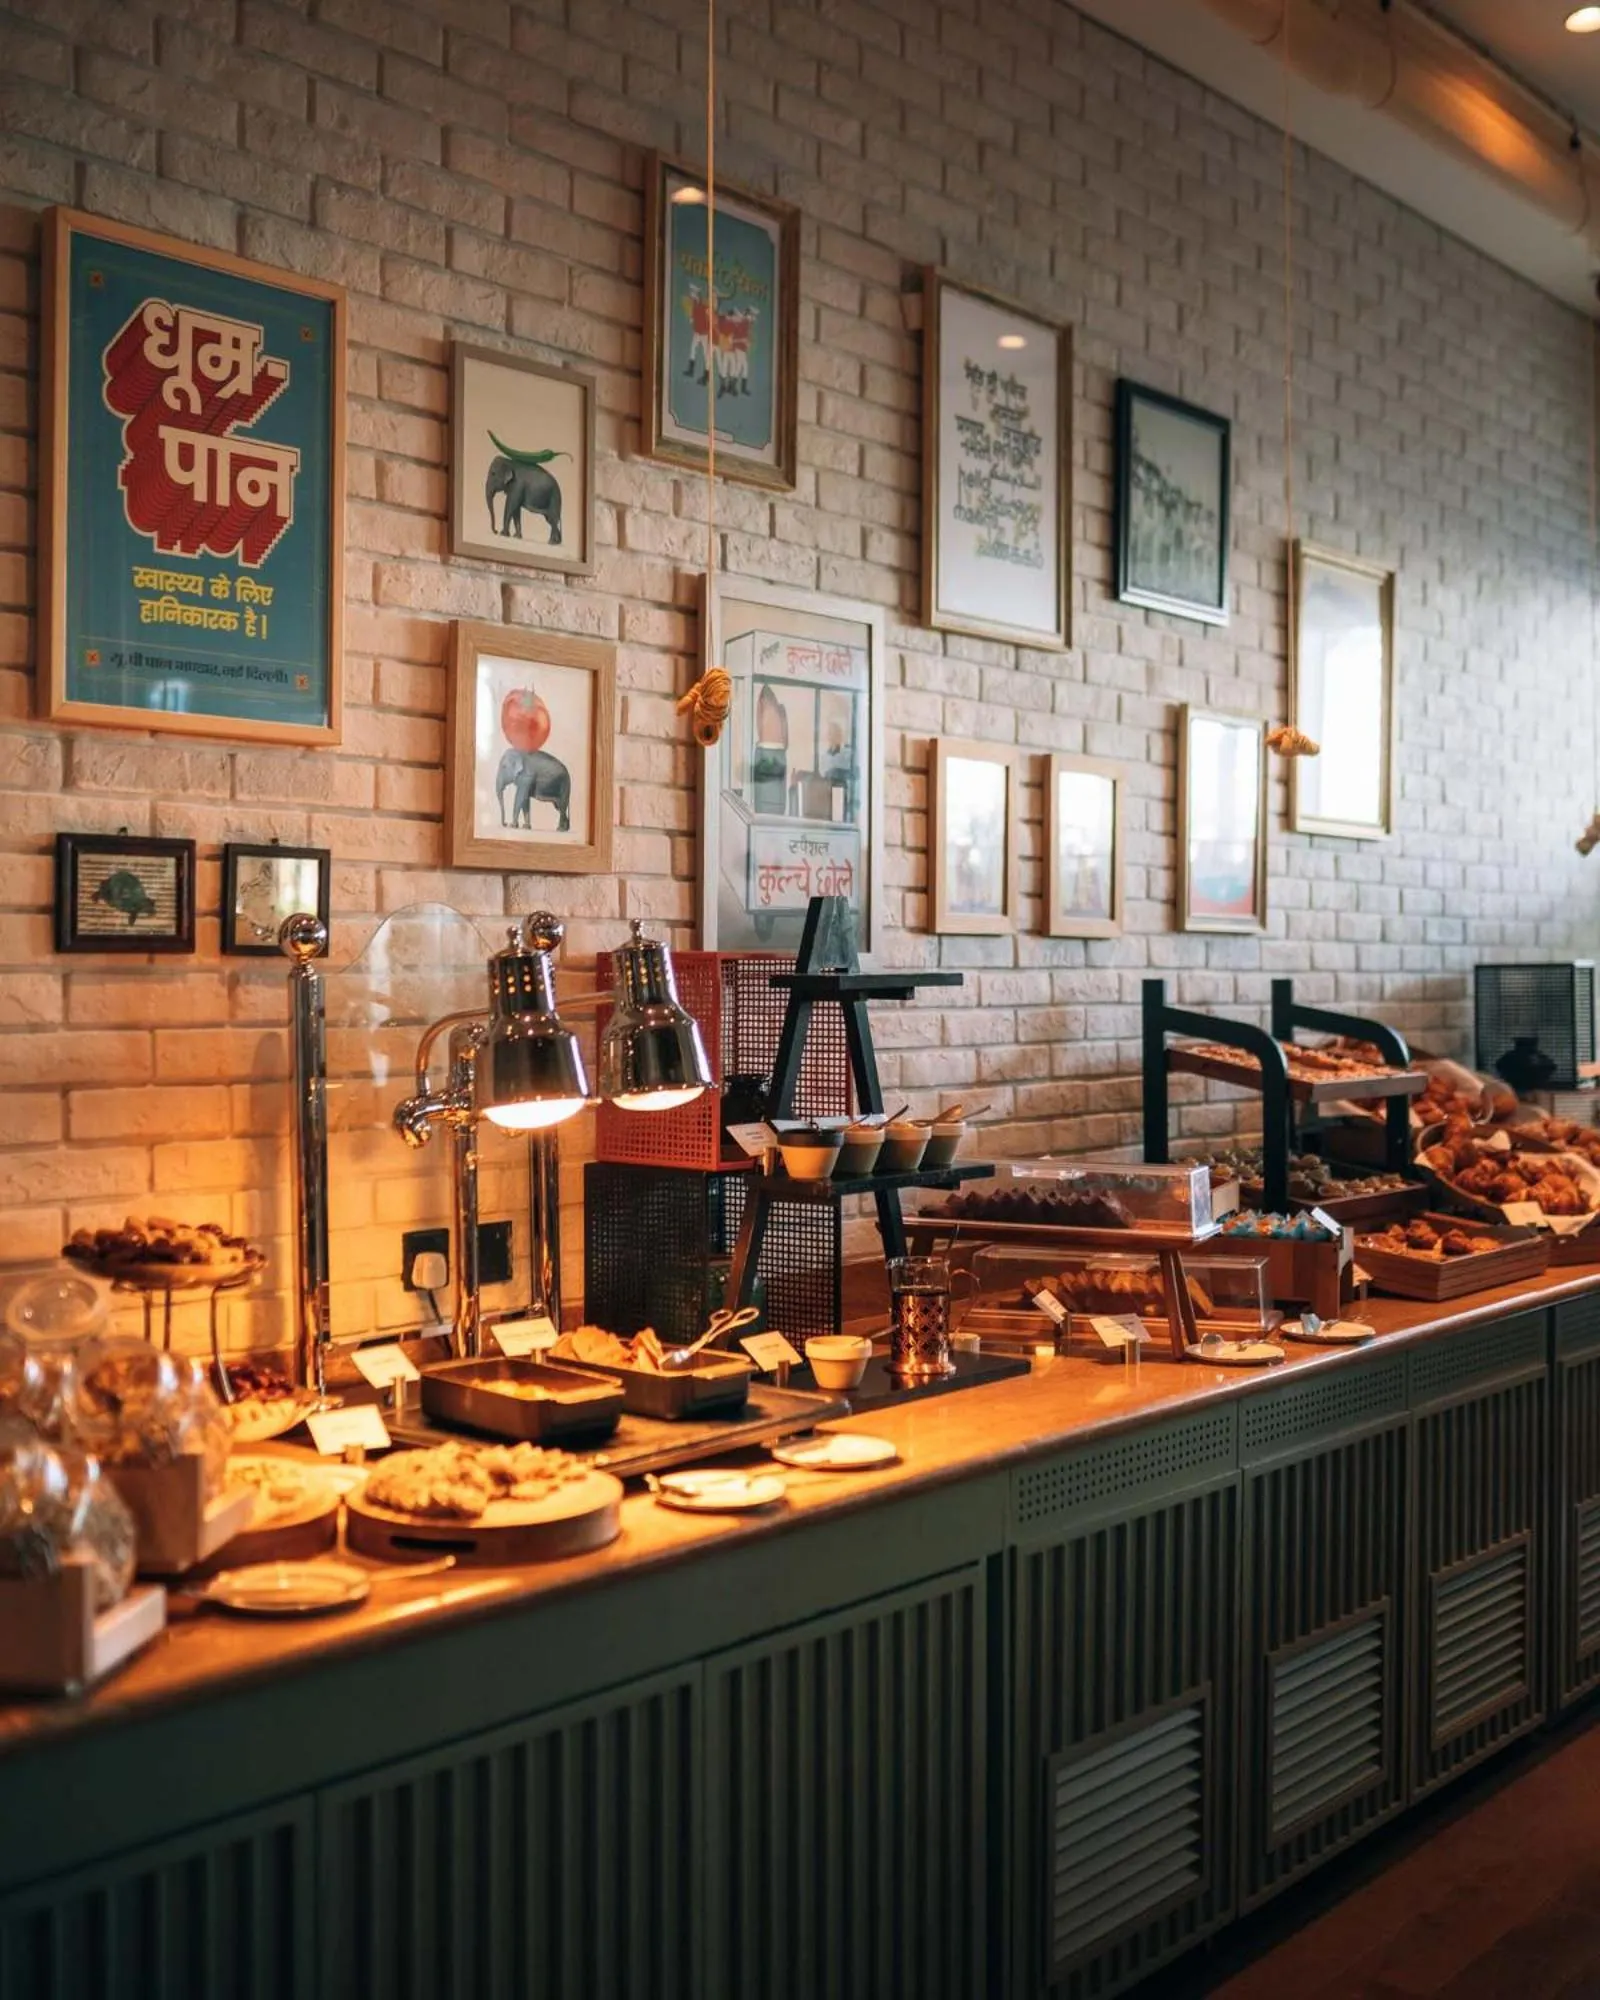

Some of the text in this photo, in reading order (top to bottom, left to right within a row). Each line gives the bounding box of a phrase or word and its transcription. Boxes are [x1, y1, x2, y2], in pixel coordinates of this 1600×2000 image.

[156, 423, 300, 521] पान
[132, 566, 275, 606] स्वास्थ्य के लिए
[758, 857, 811, 905] कुल्चे
